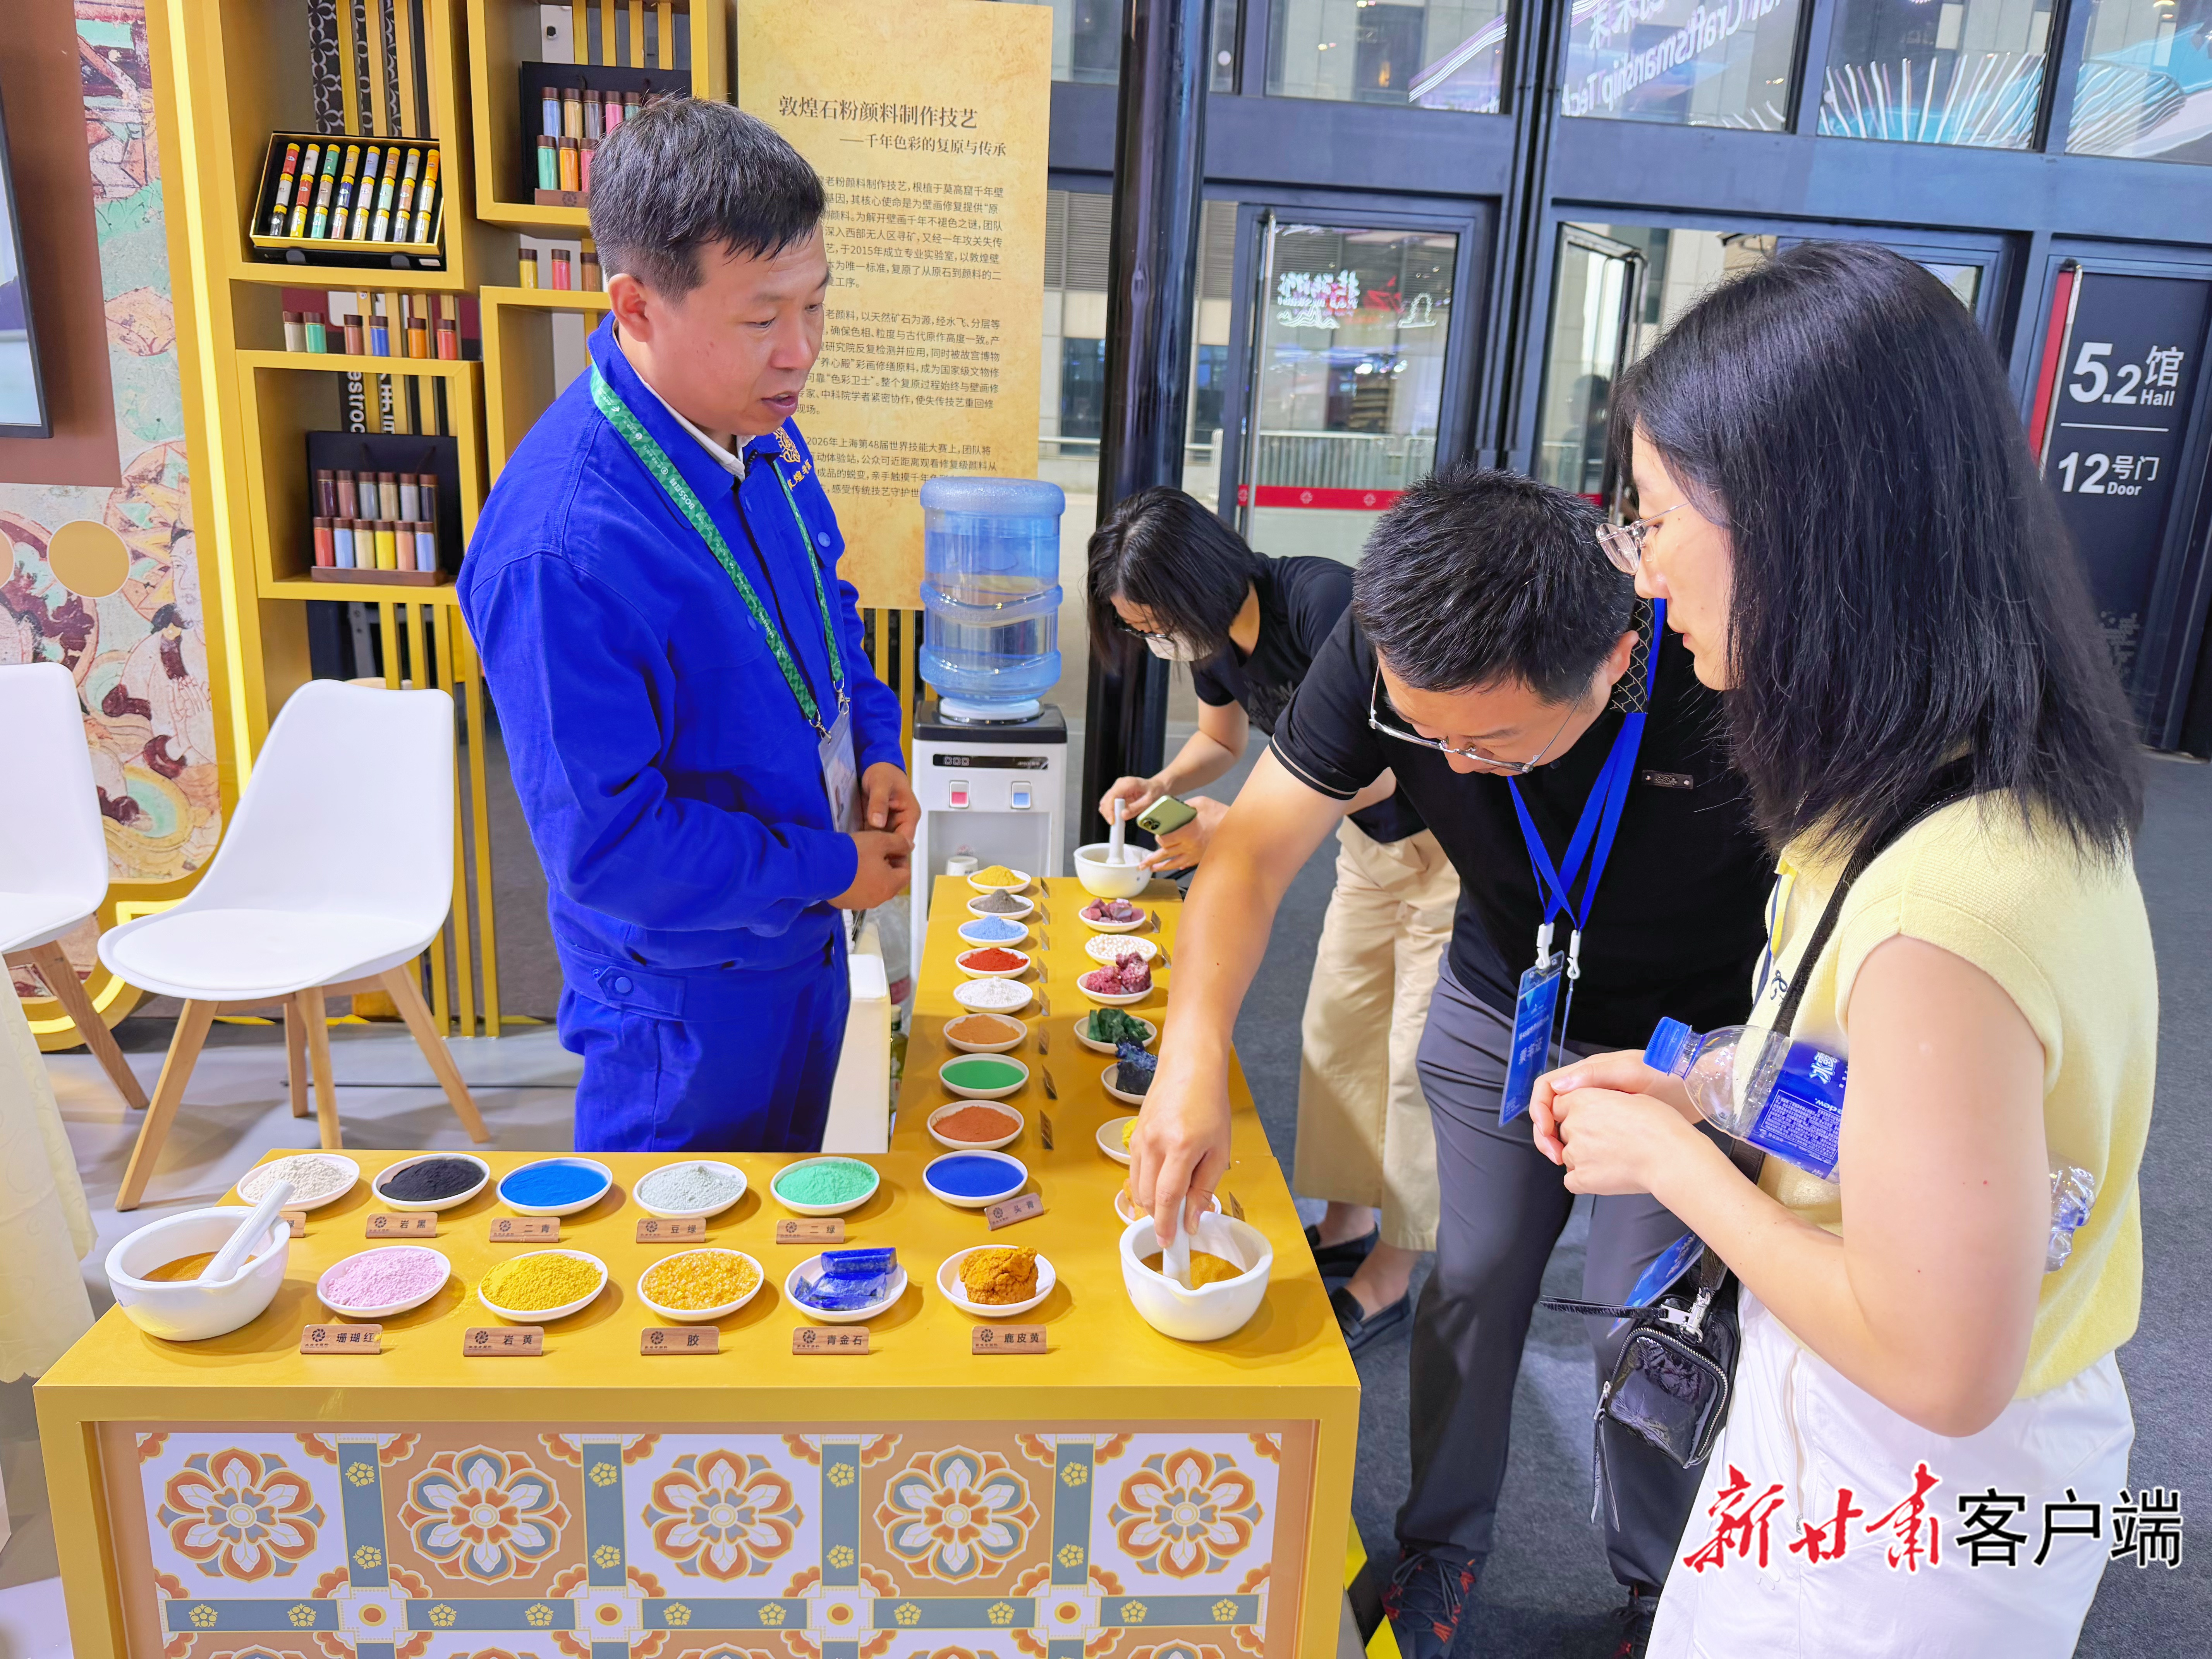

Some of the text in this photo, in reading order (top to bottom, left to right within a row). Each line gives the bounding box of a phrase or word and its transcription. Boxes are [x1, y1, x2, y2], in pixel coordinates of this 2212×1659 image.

[779, 95, 978, 129] 敦煌石粉颜料制作技艺
[820, 176, 1004, 198] 老粉颜料制作技艺，根植于莫高窟千年壁
[828, 210, 1002, 232] 颜料。为解开壁画千年不褪色之谜，团队
[823, 326, 1000, 346] ，确保色相、粒度与古代原作高度一致。产
[2140, 390, 2176, 407] Hall
[797, 404, 820, 415] 现场。
[806, 436, 991, 455] 2026年上海第48届世界技能大赛上，团队将
[815, 468, 953, 483] 成品的蜕变，亲手触摸千年
[2107, 481, 2142, 496] Door
[759, 612, 775, 639] SAMSUNG
[670, 1225, 696, 1233] 豆绿
[336, 1332, 375, 1343] 珊瑚红
[503, 1334, 533, 1345] 岩黄
[687, 1334, 700, 1346] 胶
[827, 1334, 863, 1345] 青金石
[1004, 1333, 1039, 1343] 鹿皮黄
